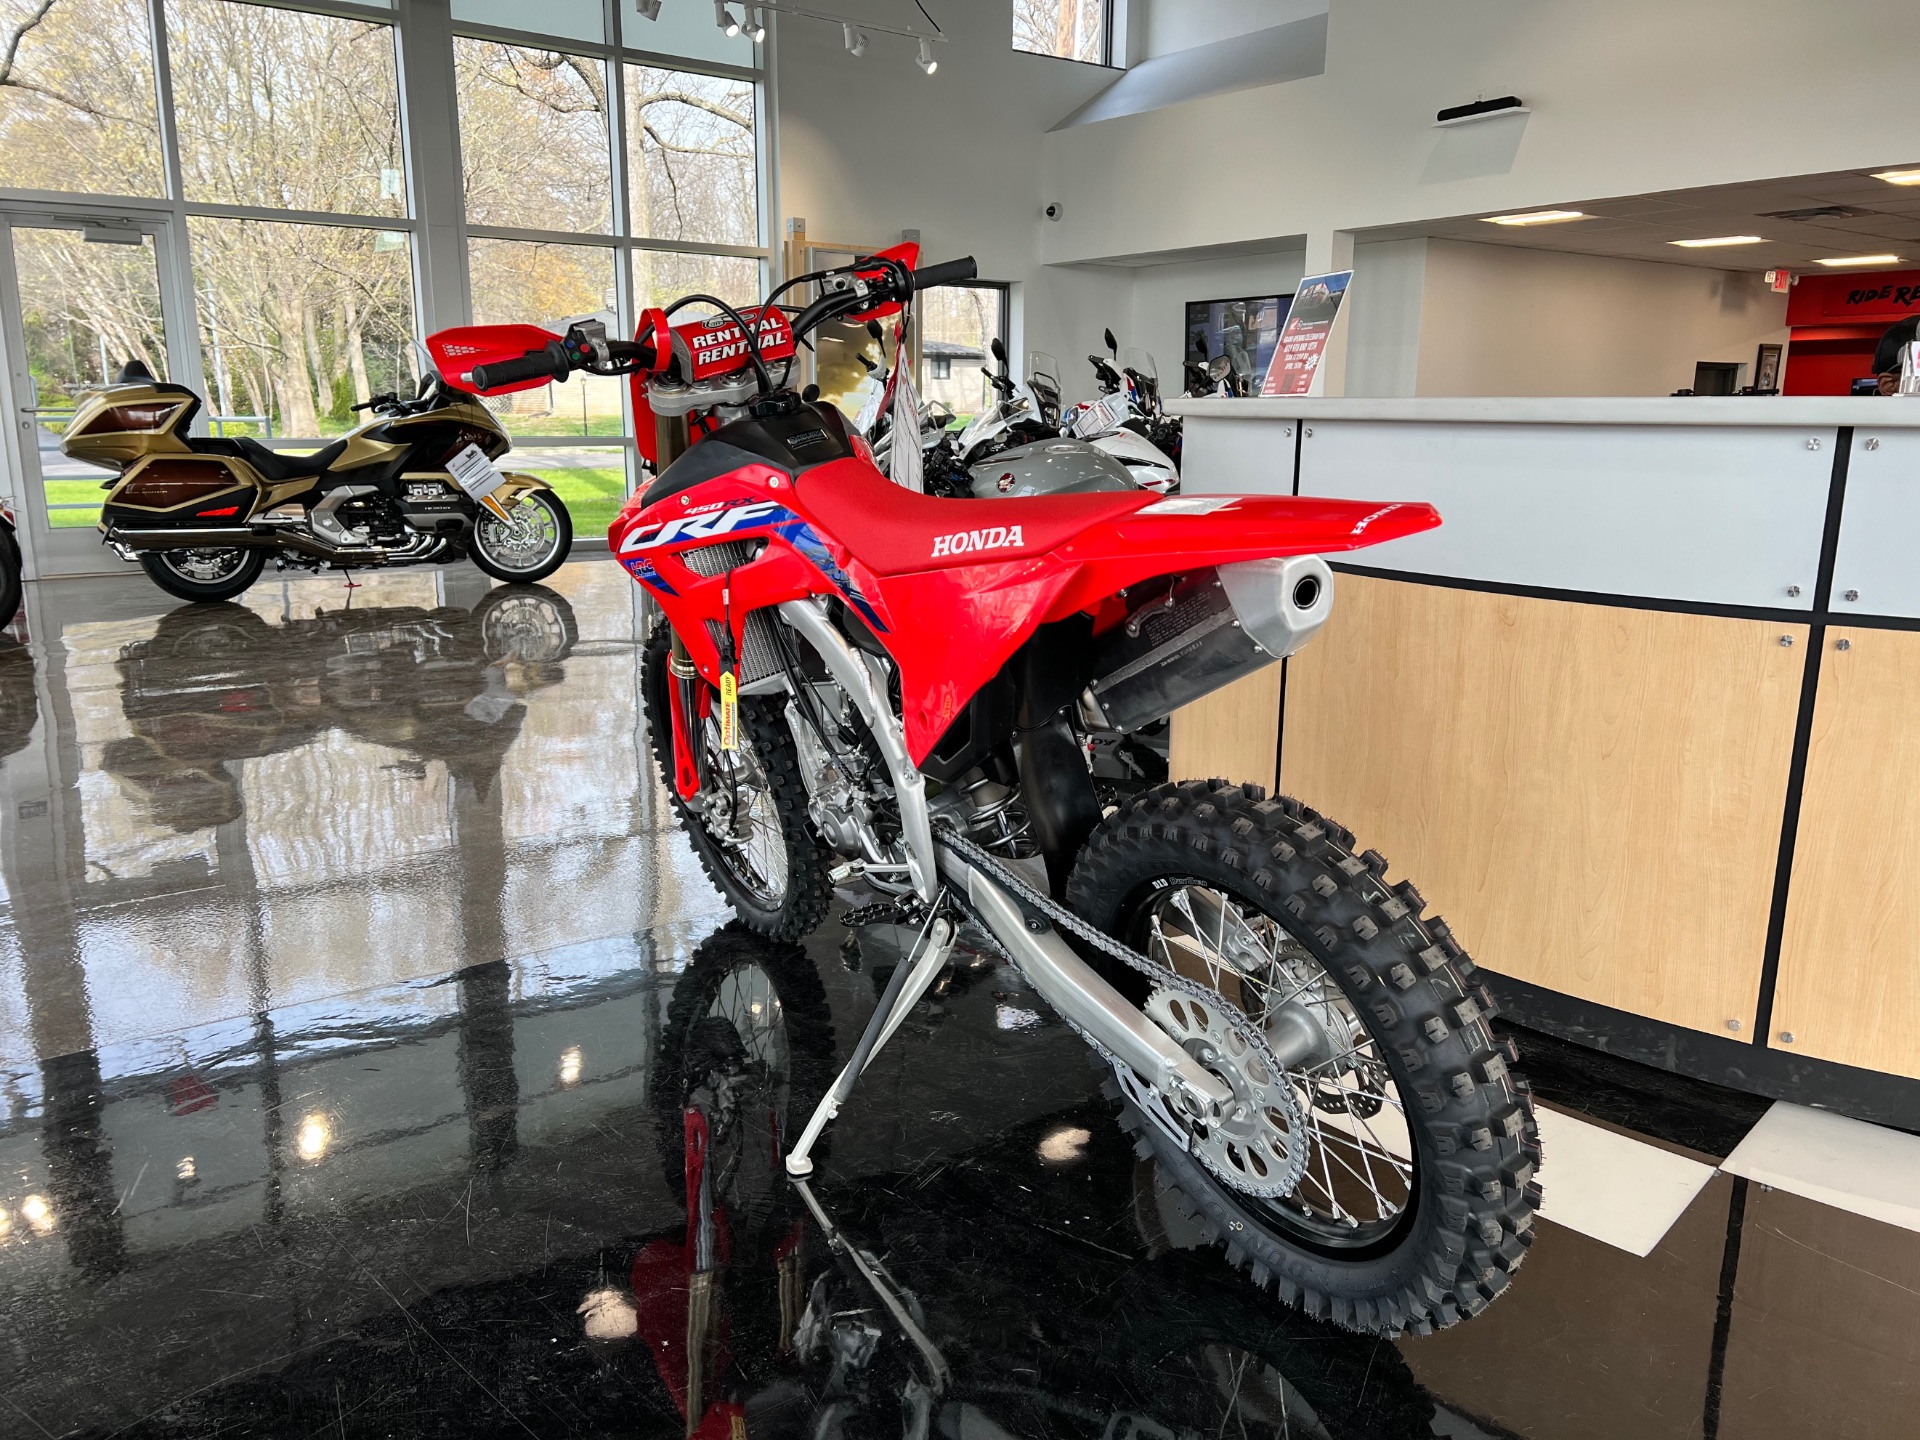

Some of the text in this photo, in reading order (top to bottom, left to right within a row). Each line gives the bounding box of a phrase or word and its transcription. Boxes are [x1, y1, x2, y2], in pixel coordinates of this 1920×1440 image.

[1846, 285, 1894, 305] RIDE
[684, 496, 757, 515] 450RX
[1350, 504, 1402, 534] HOND
[618, 501, 782, 554] CRF
[931, 525, 1024, 557] HONDA
